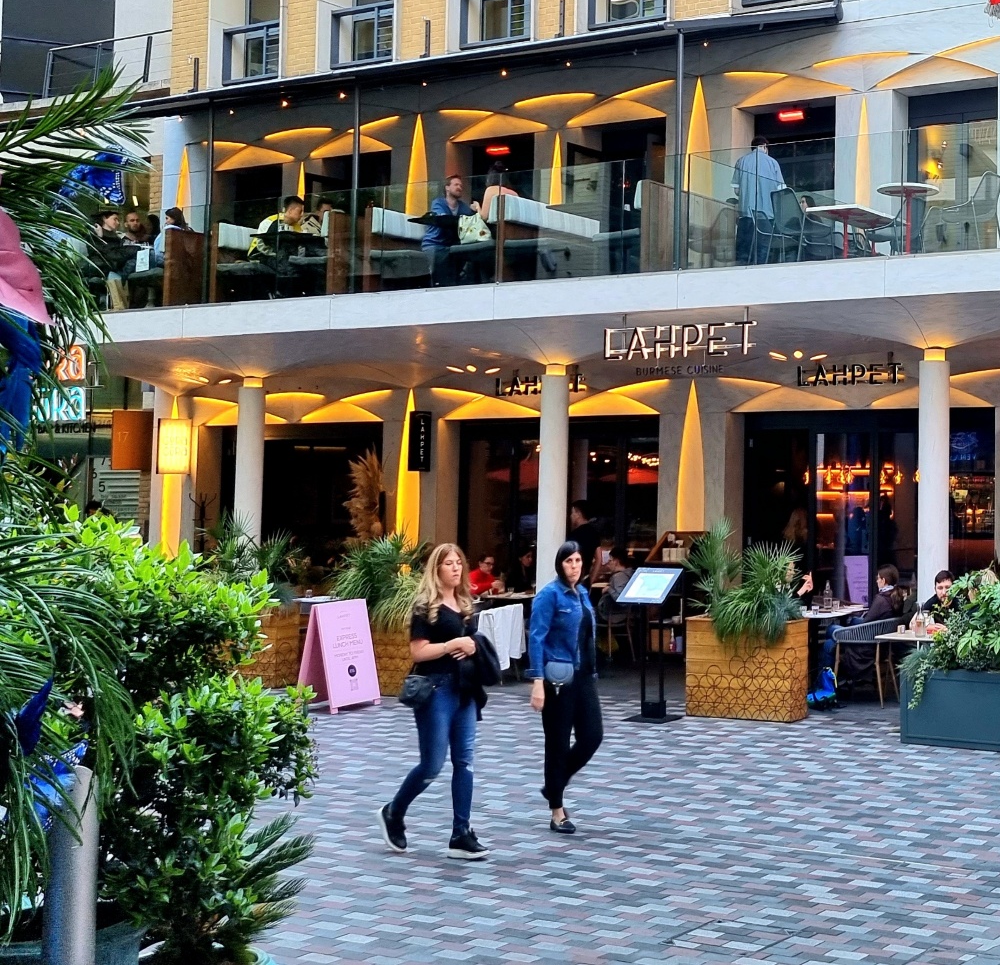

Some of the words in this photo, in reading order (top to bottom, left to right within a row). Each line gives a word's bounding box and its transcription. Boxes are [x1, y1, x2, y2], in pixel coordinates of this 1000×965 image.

[604, 320, 757, 361] LAHPET
[636, 366, 683, 377] BURMESE
[686, 364, 724, 375] CUISINE
[797, 362, 902, 387] LAHPET
[495, 373, 585, 397] LAHT
[98, 481, 106, 493] 5
[337, 633, 357, 641] EXPRESS
